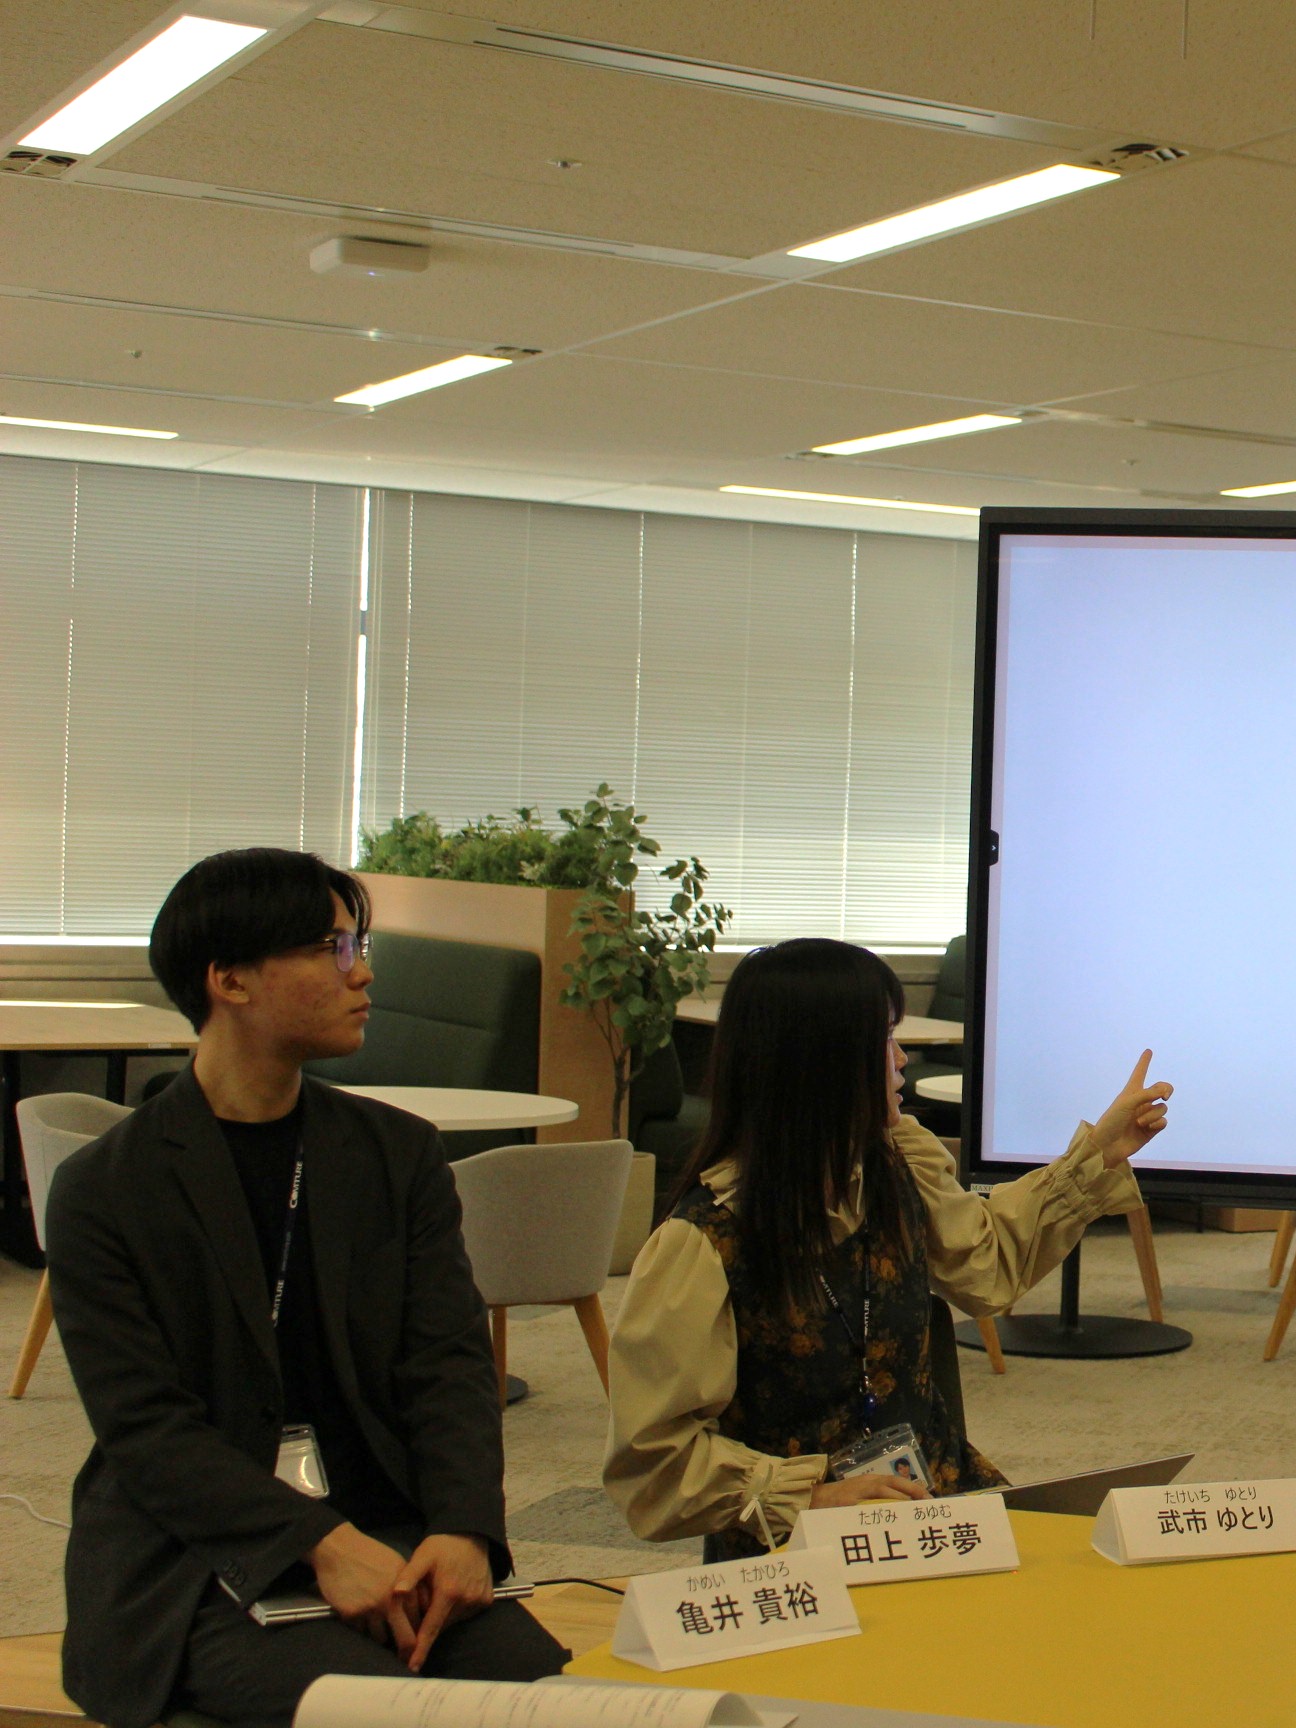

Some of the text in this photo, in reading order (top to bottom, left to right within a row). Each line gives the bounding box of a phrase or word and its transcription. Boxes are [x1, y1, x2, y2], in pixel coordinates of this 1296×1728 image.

[1163, 1486, 1258, 1504] たけいち ゆとり
[858, 1504, 952, 1526] たがみ あゆむ
[1156, 1505, 1275, 1535] 武市 ゆとり
[840, 1521, 982, 1567] 田上 歩夢
[686, 1560, 790, 1592] かめい たかひろ
[676, 1581, 820, 1636] 亀井 貴裕
